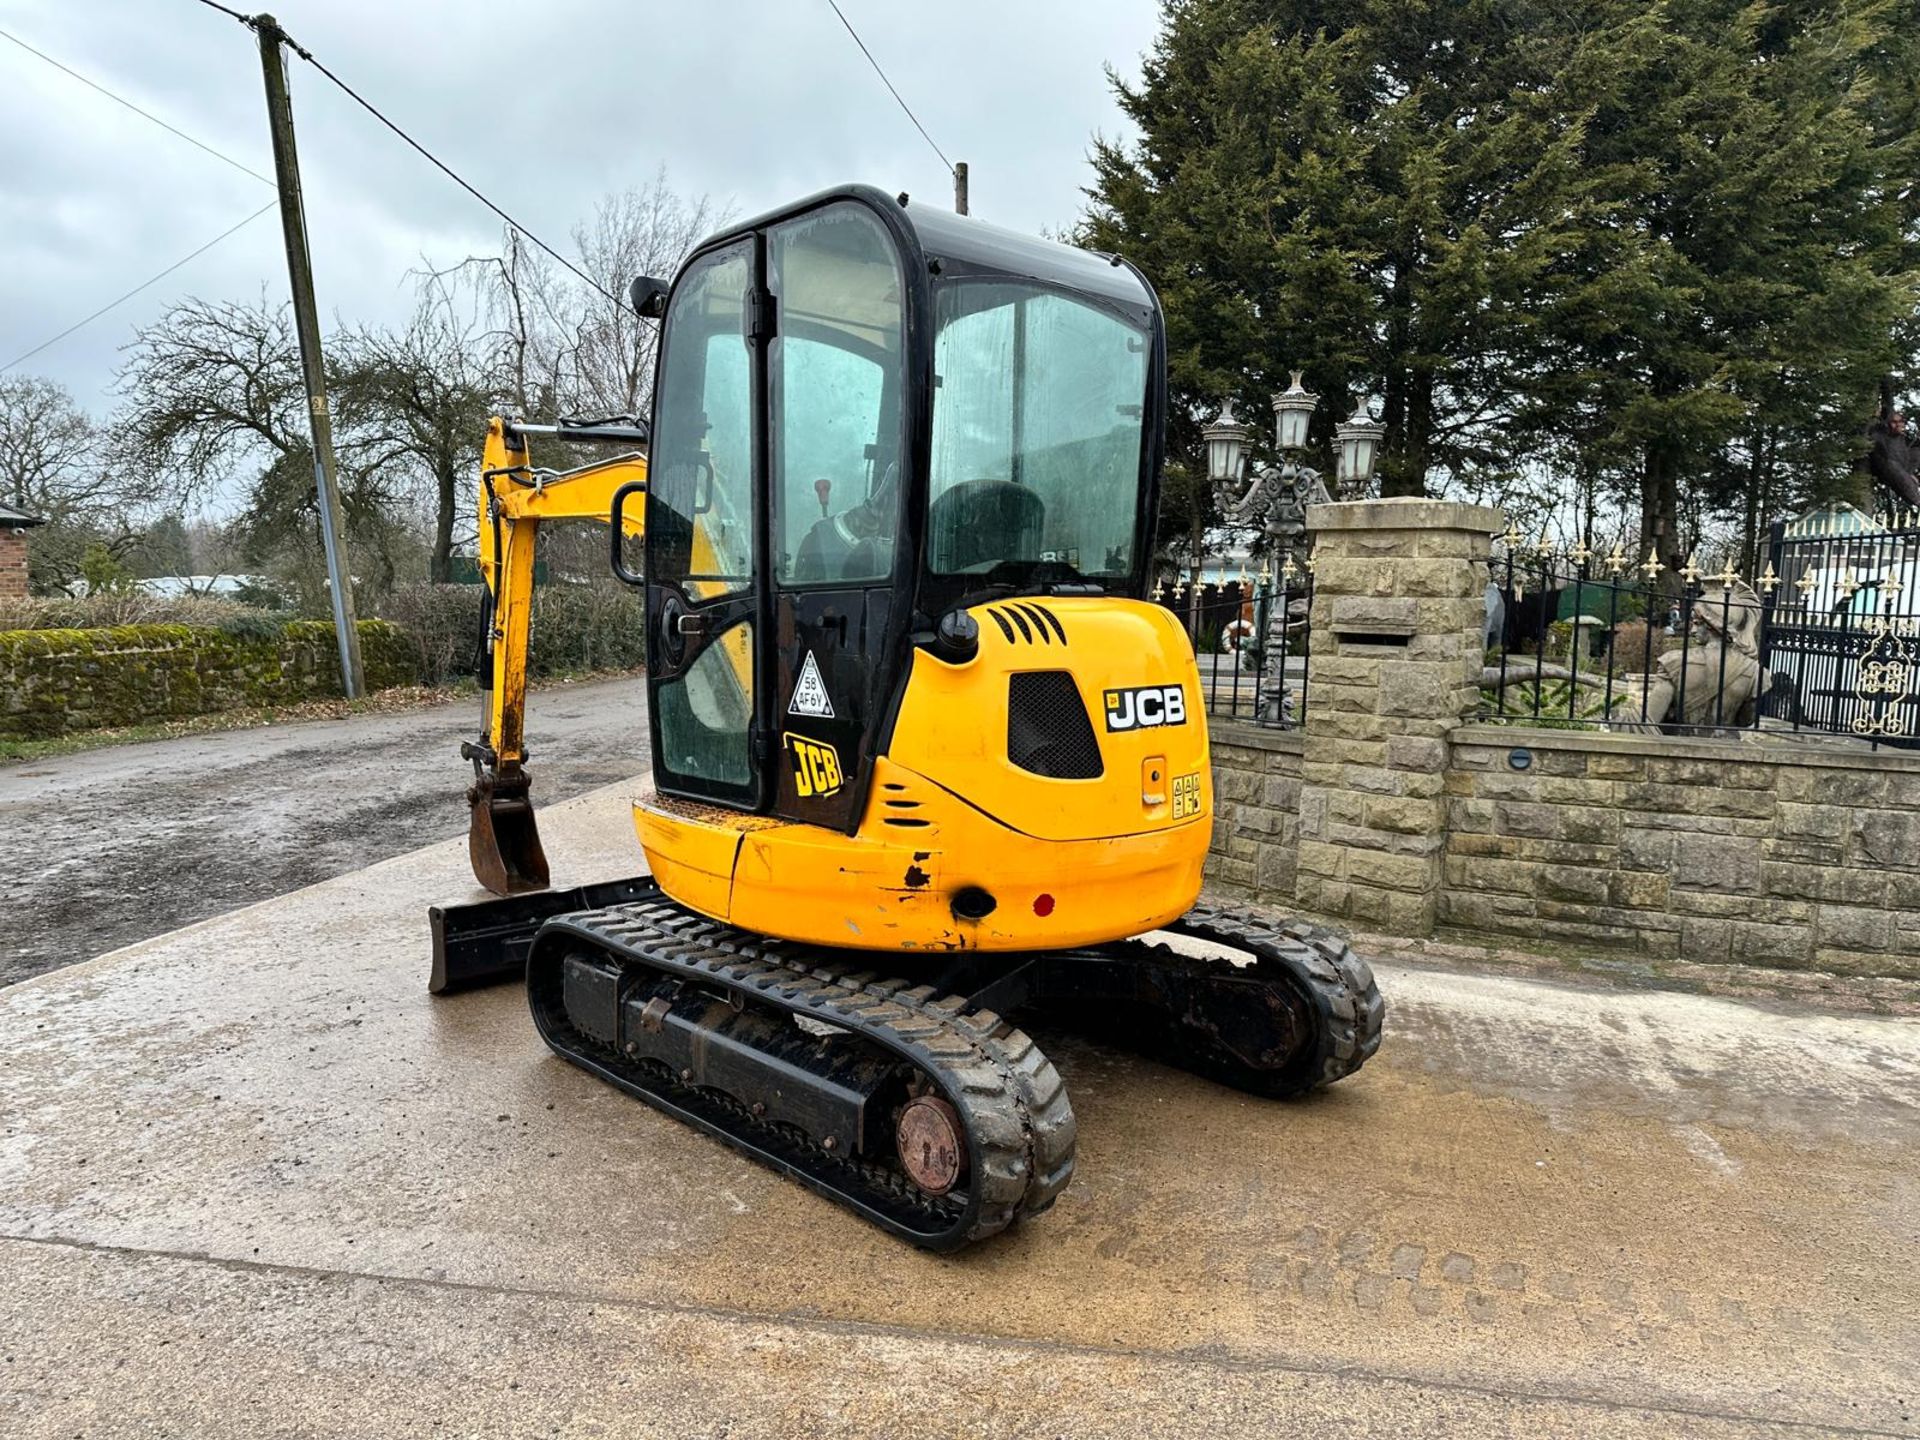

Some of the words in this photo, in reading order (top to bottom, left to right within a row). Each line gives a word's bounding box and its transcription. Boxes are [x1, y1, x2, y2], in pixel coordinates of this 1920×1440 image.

[804, 676, 817, 690] 58
[799, 692, 822, 707] AF6Y
[1108, 687, 1185, 728] JCB
[793, 740, 840, 798] JCB
